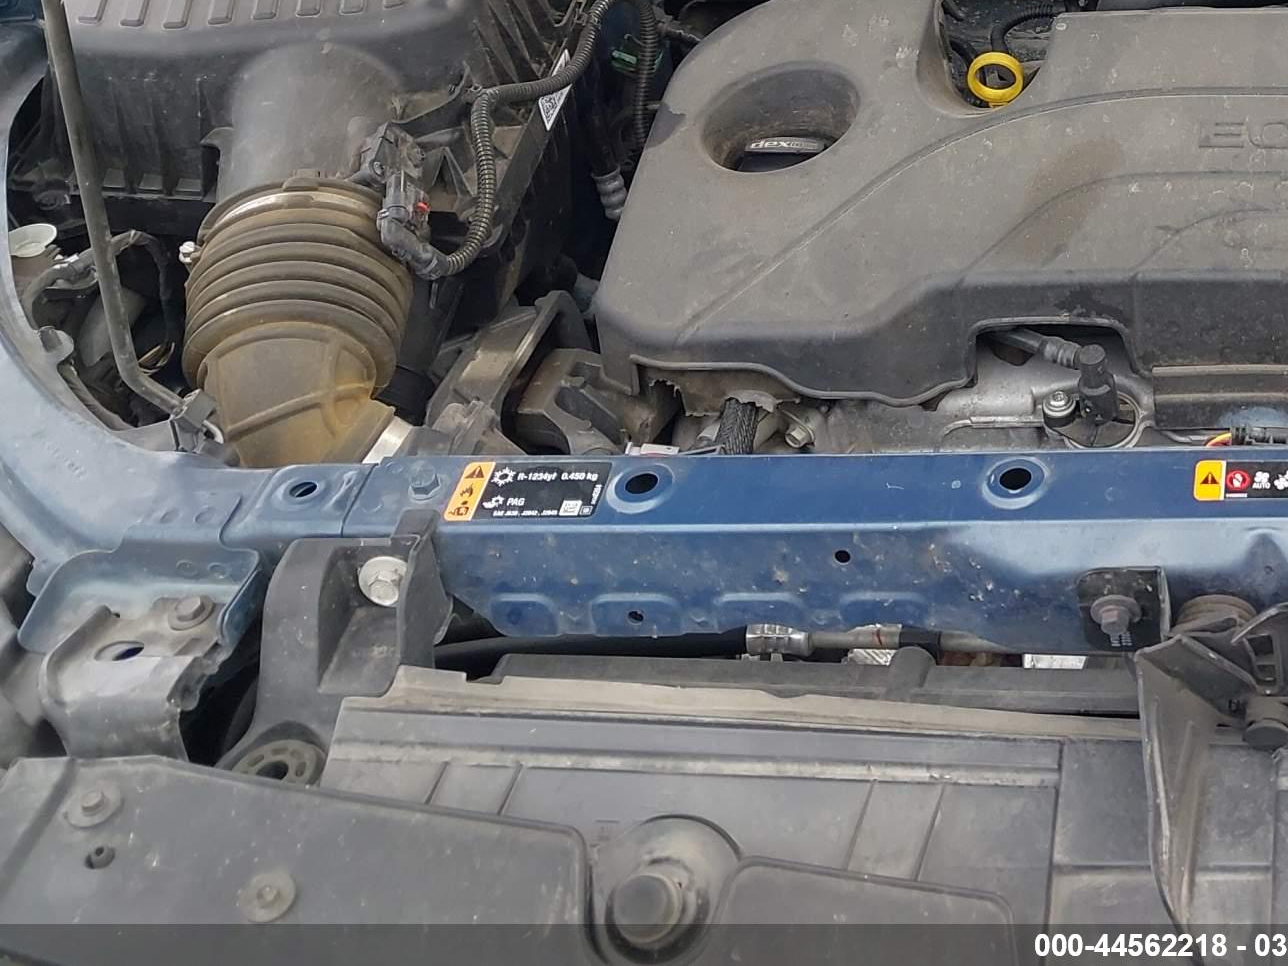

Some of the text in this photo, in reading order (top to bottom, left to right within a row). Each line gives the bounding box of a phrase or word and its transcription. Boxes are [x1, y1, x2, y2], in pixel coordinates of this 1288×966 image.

[517, 472, 598, 482] R-1234yf 0.450 kg
[1252, 482, 1270, 490] AUTO
[506, 498, 525, 506] PAG
